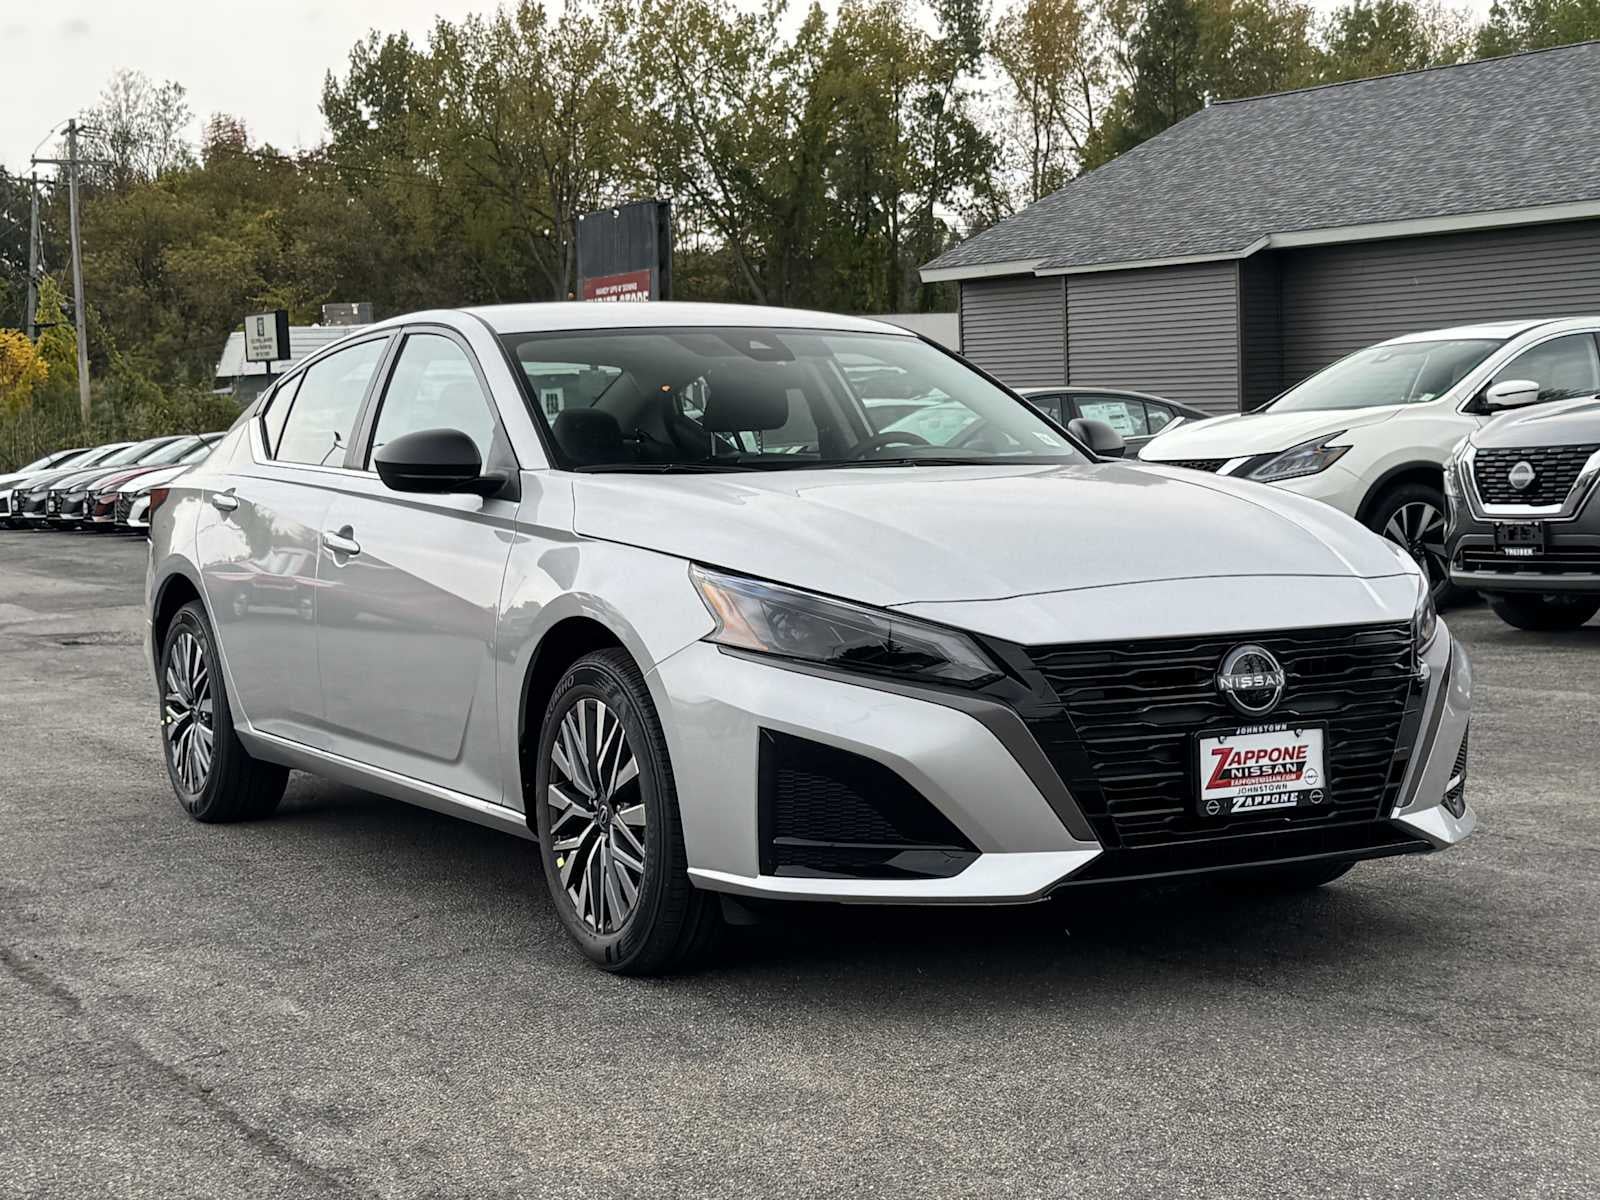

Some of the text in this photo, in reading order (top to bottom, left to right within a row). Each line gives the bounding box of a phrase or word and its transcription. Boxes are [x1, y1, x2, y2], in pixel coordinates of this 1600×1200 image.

[1220, 671, 1284, 689] NISSAN
[1235, 723, 1288, 735] JOHNSTOWN
[1205, 744, 1309, 790] ZAPPONE
[1231, 763, 1298, 778] NISSAN
[1237, 784, 1288, 795] JOHNSTOWN
[1230, 792, 1298, 813] ZAPPONE
